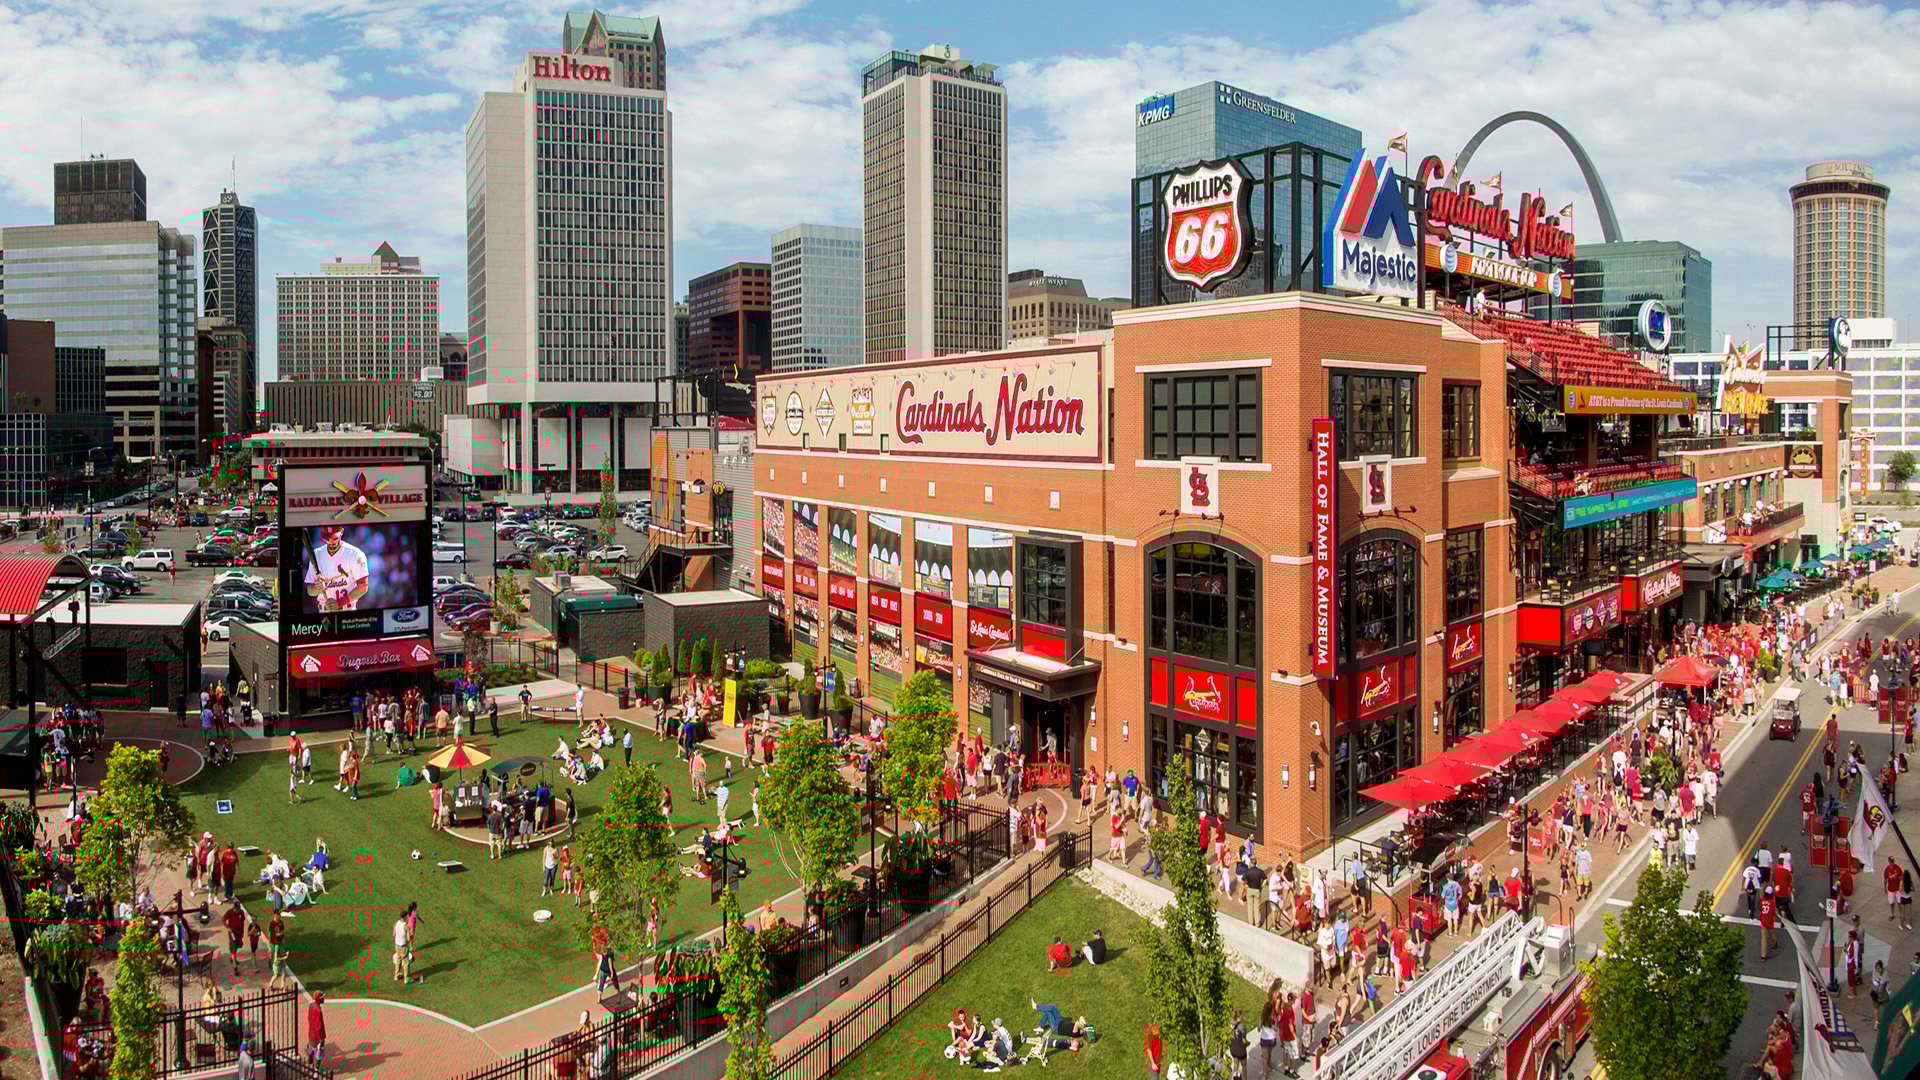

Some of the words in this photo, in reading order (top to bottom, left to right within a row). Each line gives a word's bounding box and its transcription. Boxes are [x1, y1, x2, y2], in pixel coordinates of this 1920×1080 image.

[533, 55, 611, 82] Hilton
[1138, 105, 1170, 127] KPMG
[1173, 174, 1232, 206] PHILLIPS
[1414, 155, 1512, 242] Cardinals
[1506, 192, 1575, 260] Nation
[1175, 211, 1228, 264] 66
[1342, 238, 1416, 284] Majestic
[896, 380, 987, 444] Cardinals
[985, 373, 1085, 446] Nation
[1317, 432, 1329, 480] HALL
[288, 496, 343, 508] BALLPARK
[378, 493, 423, 504] VILLAGE
[1317, 484, 1328, 509] OF
[1317, 514, 1329, 561] FAME
[1317, 565, 1329, 582] &
[397, 610, 416, 621] Ford
[1317, 584, 1329, 666] MUSEUM
[291, 623, 322, 636] Mercy
[989, 625, 1009, 640] Cardinals
[339, 653, 377, 670] Dugout
[380, 650, 401, 663] Bar
[1761, 905, 1770, 914] 37
[1403, 1049, 1416, 1068] ST.
[1417, 1026, 1441, 1055] LOUIS
[1443, 1010, 1459, 1032] FIRE
[1460, 966, 1504, 1014] DEPARTMENT
